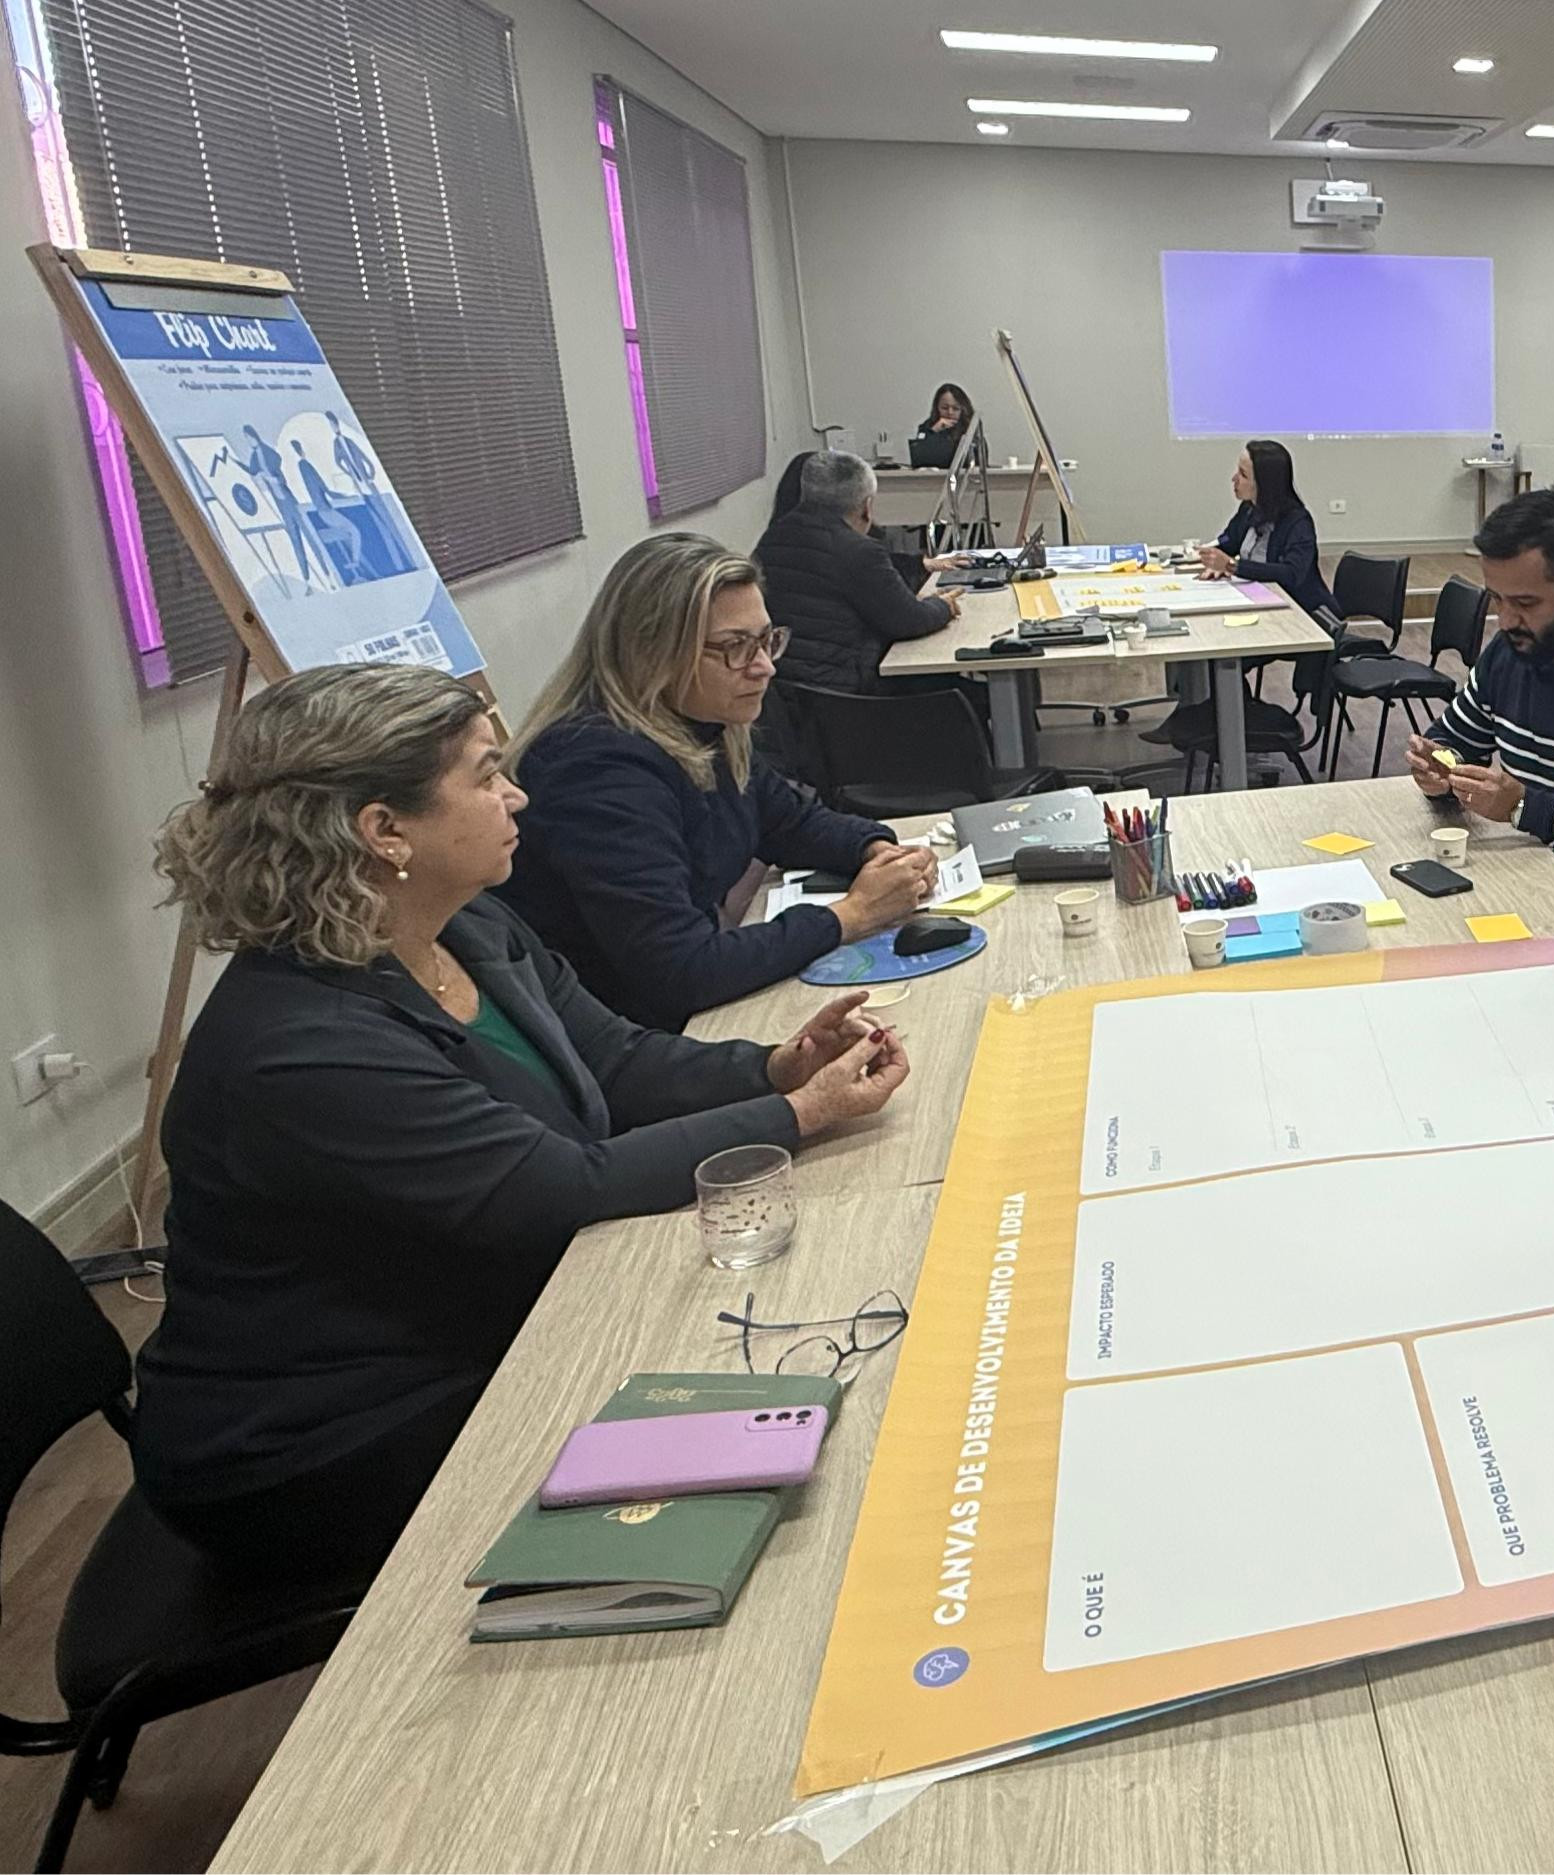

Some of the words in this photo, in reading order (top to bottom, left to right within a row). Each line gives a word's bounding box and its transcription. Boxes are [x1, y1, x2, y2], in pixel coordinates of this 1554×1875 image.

[153, 311, 213, 358] Flip
[208, 315, 277, 351] Chart
[998, 1191, 1027, 1237] IDEIA
[994, 1238, 1020, 1262] DA
[1100, 1261, 1115, 1310] ESPERADO
[1097, 1311, 1113, 1360] IMPACTO
[960, 1265, 1016, 1458] DESENVOLVIMENTO
[1462, 1395, 1492, 1450] RESOLVE
[954, 1462, 986, 1494] DE
[1480, 1450, 1516, 1524] PROBLEMA
[933, 1500, 980, 1626] CANVAS
[1502, 1525, 1525, 1556] QUE
[1081, 1572, 1103, 1583] É
[1085, 1586, 1104, 1621] QUE
[1084, 1624, 1102, 1637] O
